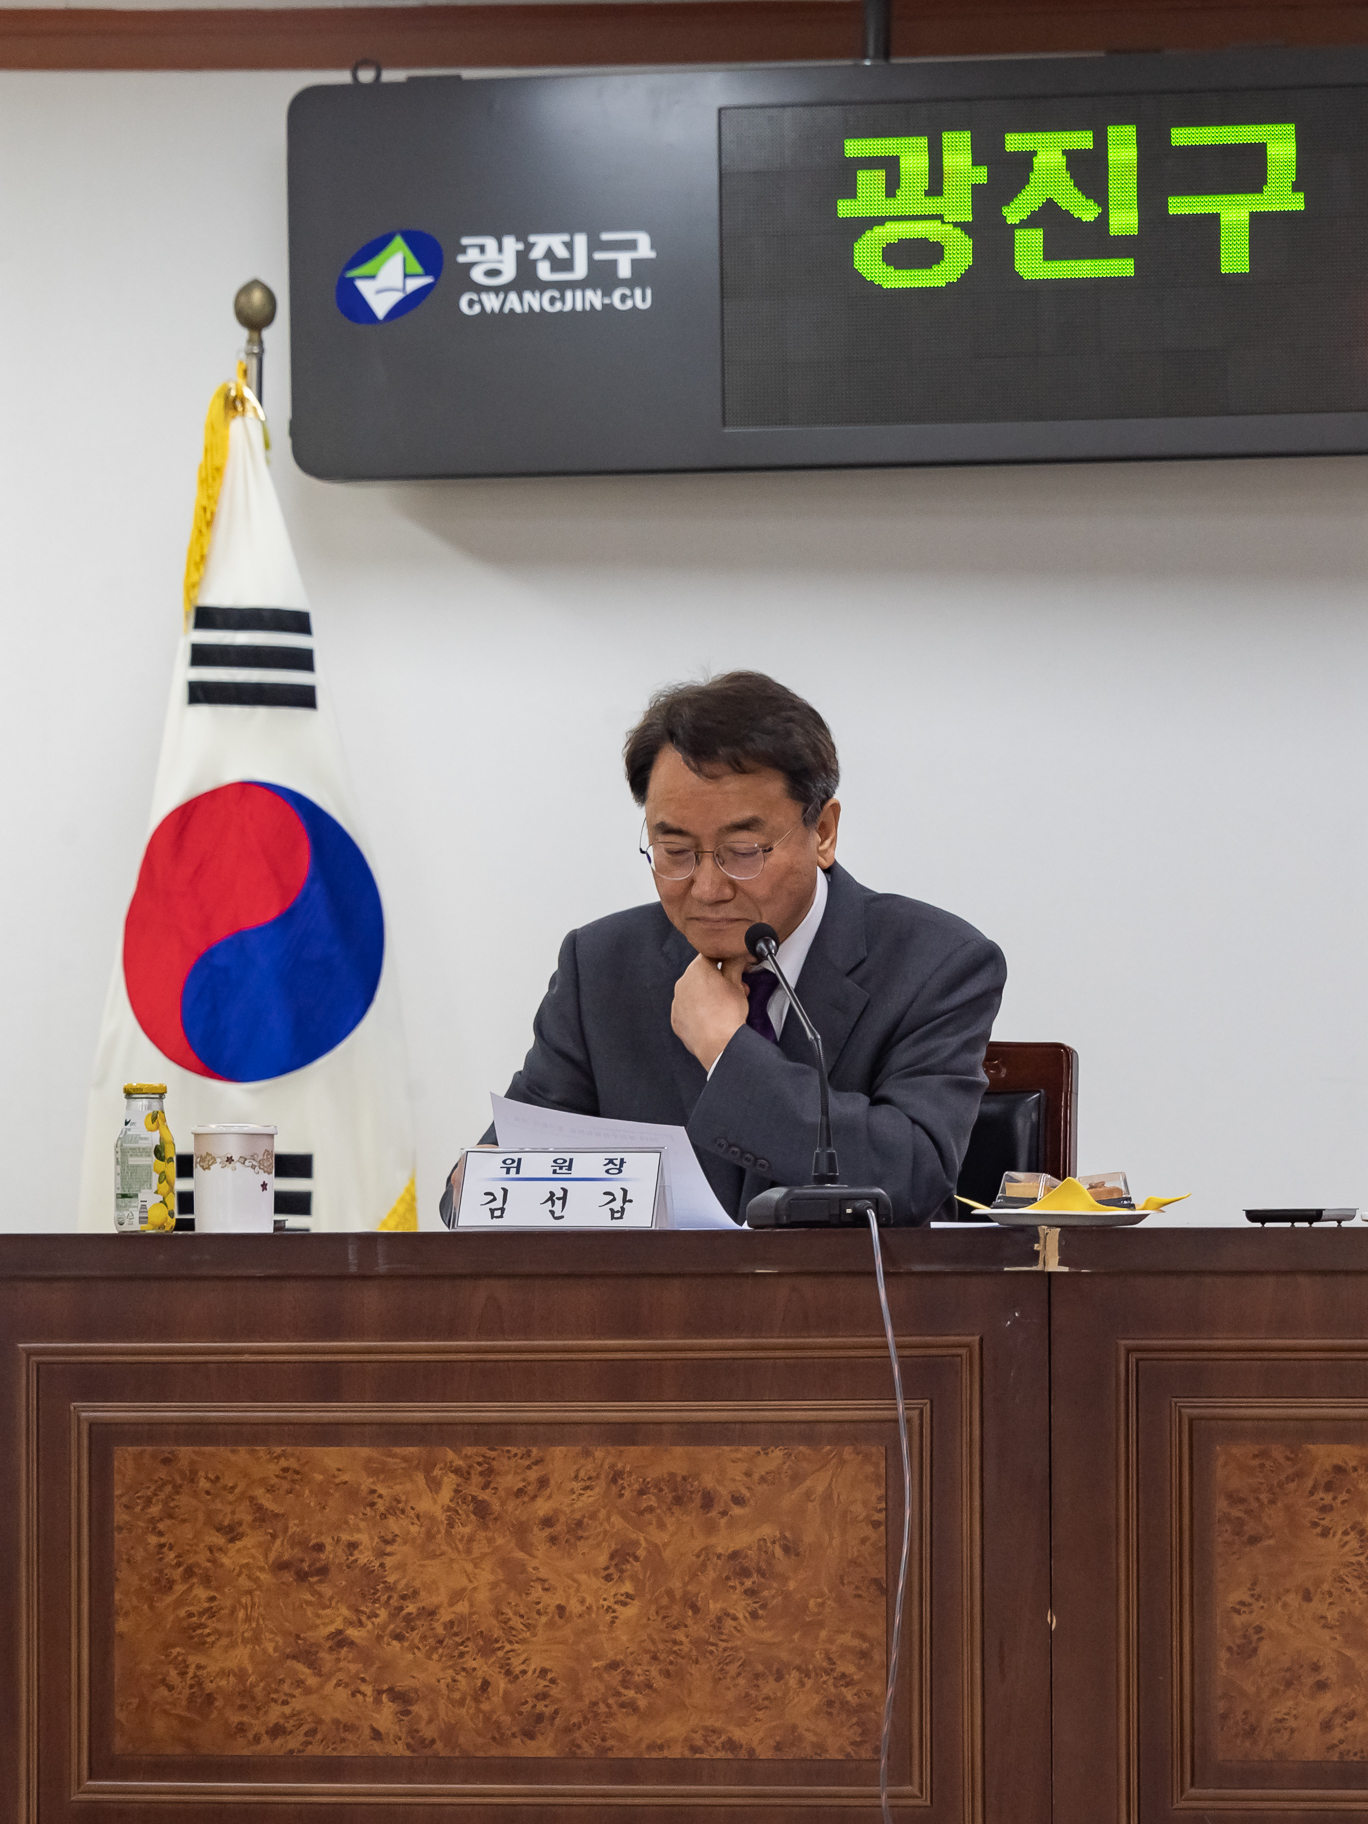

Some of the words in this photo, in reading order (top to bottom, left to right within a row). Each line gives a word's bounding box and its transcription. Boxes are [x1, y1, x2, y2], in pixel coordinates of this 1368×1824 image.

[837, 123, 1305, 289] 광진구
[456, 230, 657, 286] 광진구
[459, 286, 652, 315] GWANGJIN-GU
